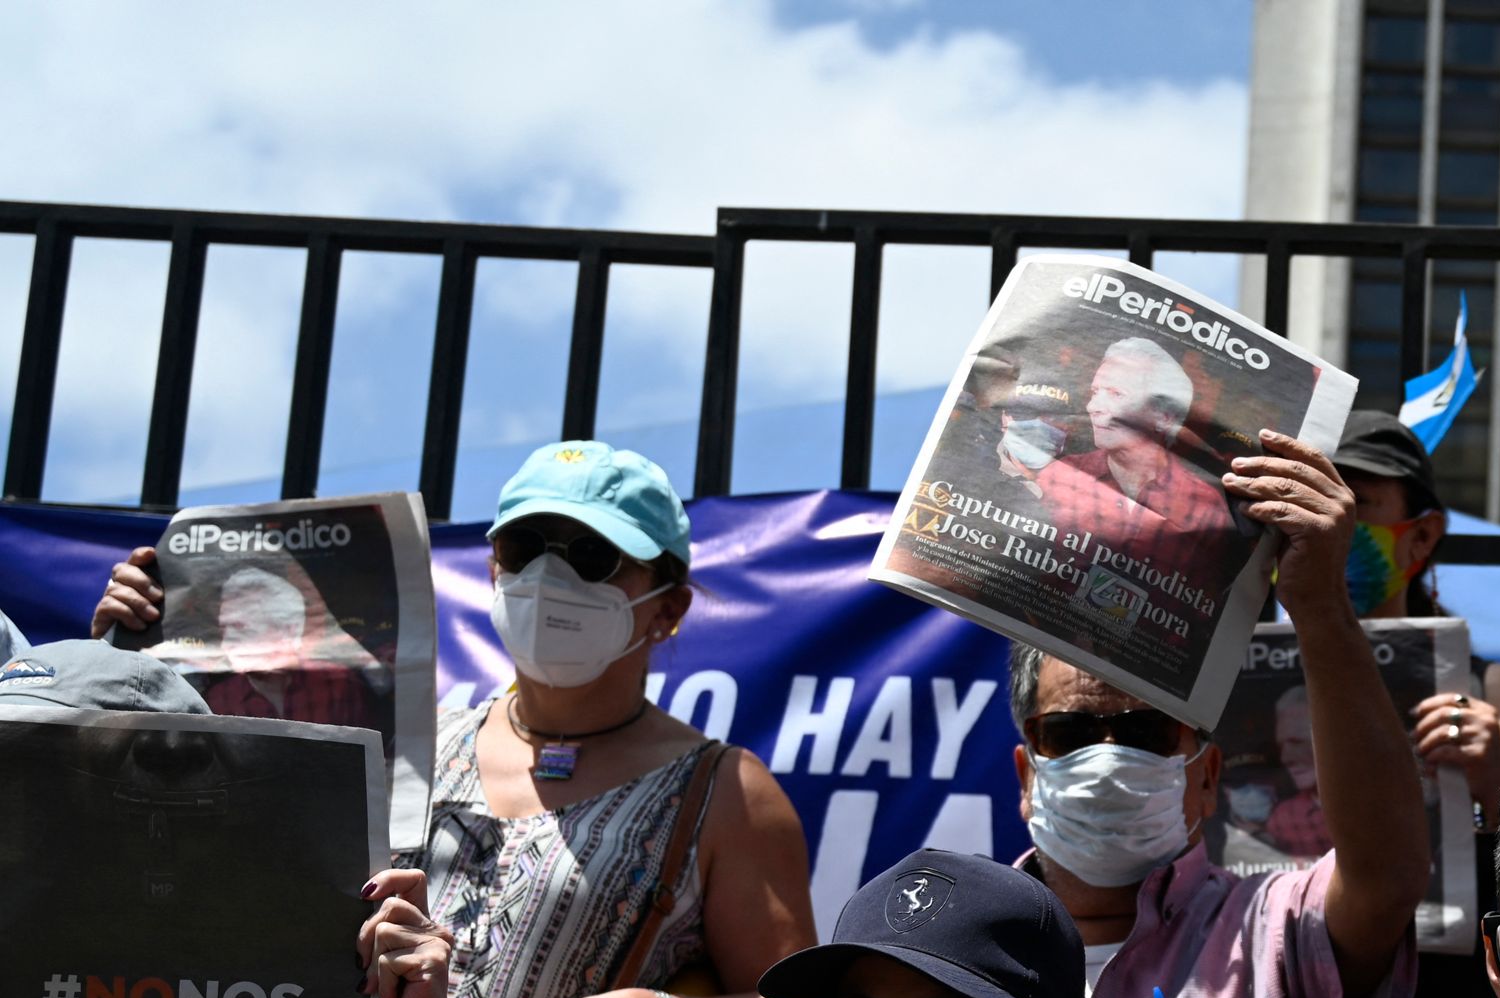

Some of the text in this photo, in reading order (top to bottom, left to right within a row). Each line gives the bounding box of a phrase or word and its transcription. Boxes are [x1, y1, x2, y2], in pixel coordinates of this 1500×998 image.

[928, 480, 1059, 543] Capturan
[1063, 529, 1093, 555] al
[1092, 542, 1216, 617] periodista
[934, 513, 1190, 639] Jose Rubén Zamora
[771, 675, 997, 779] HAY
